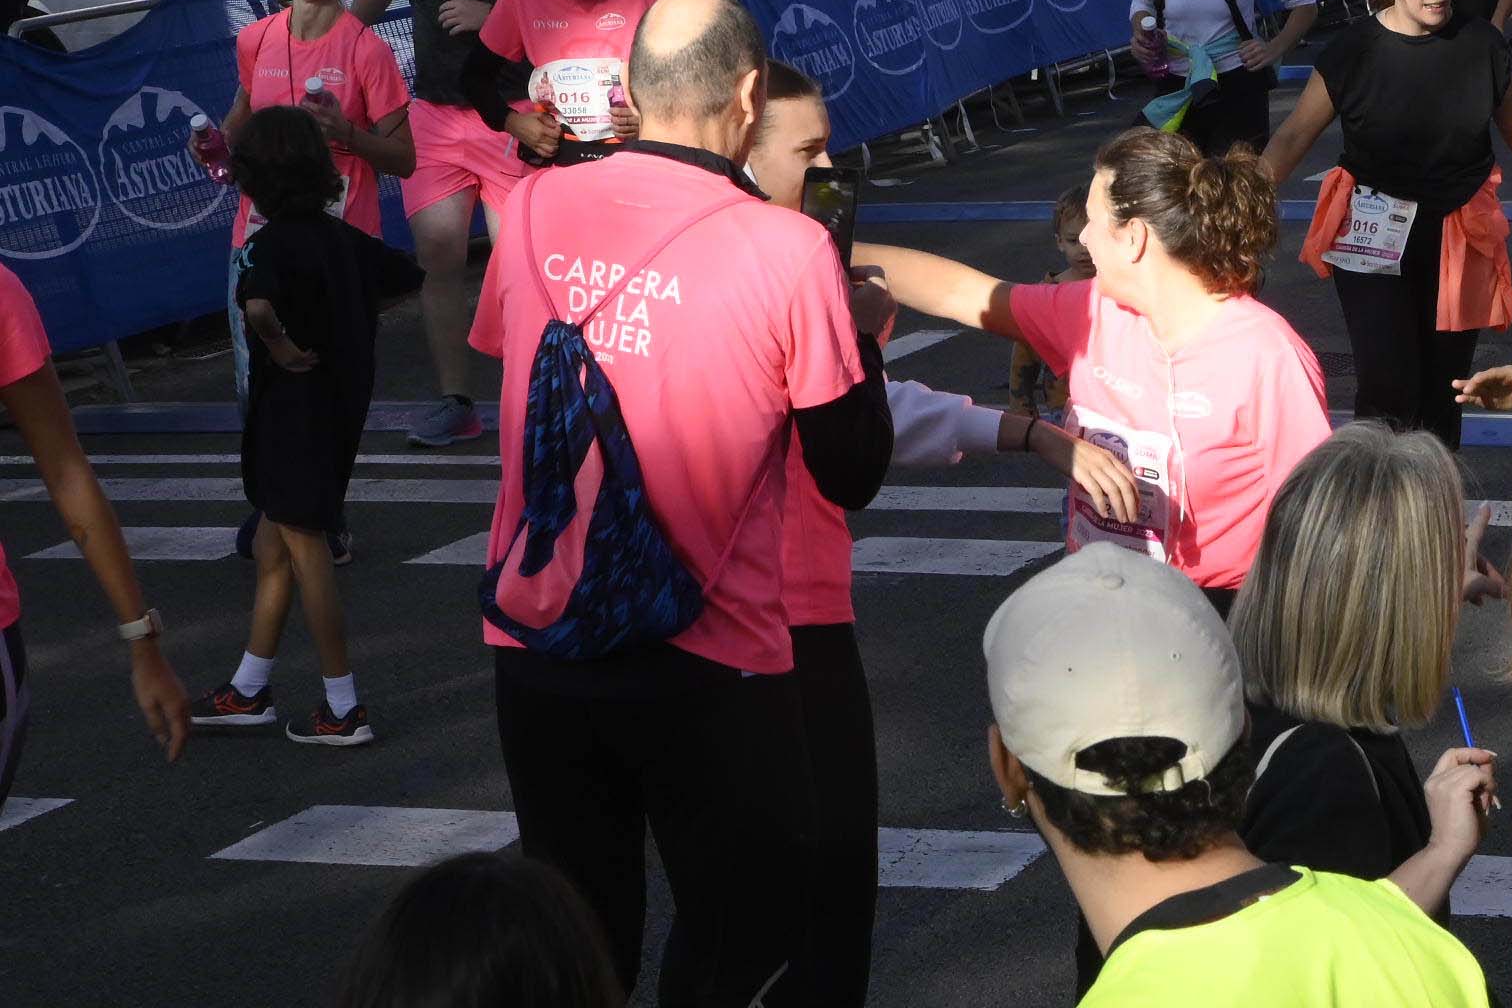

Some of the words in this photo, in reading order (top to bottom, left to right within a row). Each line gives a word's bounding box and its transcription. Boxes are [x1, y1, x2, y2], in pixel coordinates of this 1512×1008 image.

[559, 92, 590, 104] 016
[1353, 220, 1379, 234] 016
[1353, 236, 1373, 245] 16572
[544, 254, 681, 305] CARRERA
[615, 293, 650, 327] LA
[567, 312, 652, 358] UJER
[1107, 520, 1134, 537] MUJER
